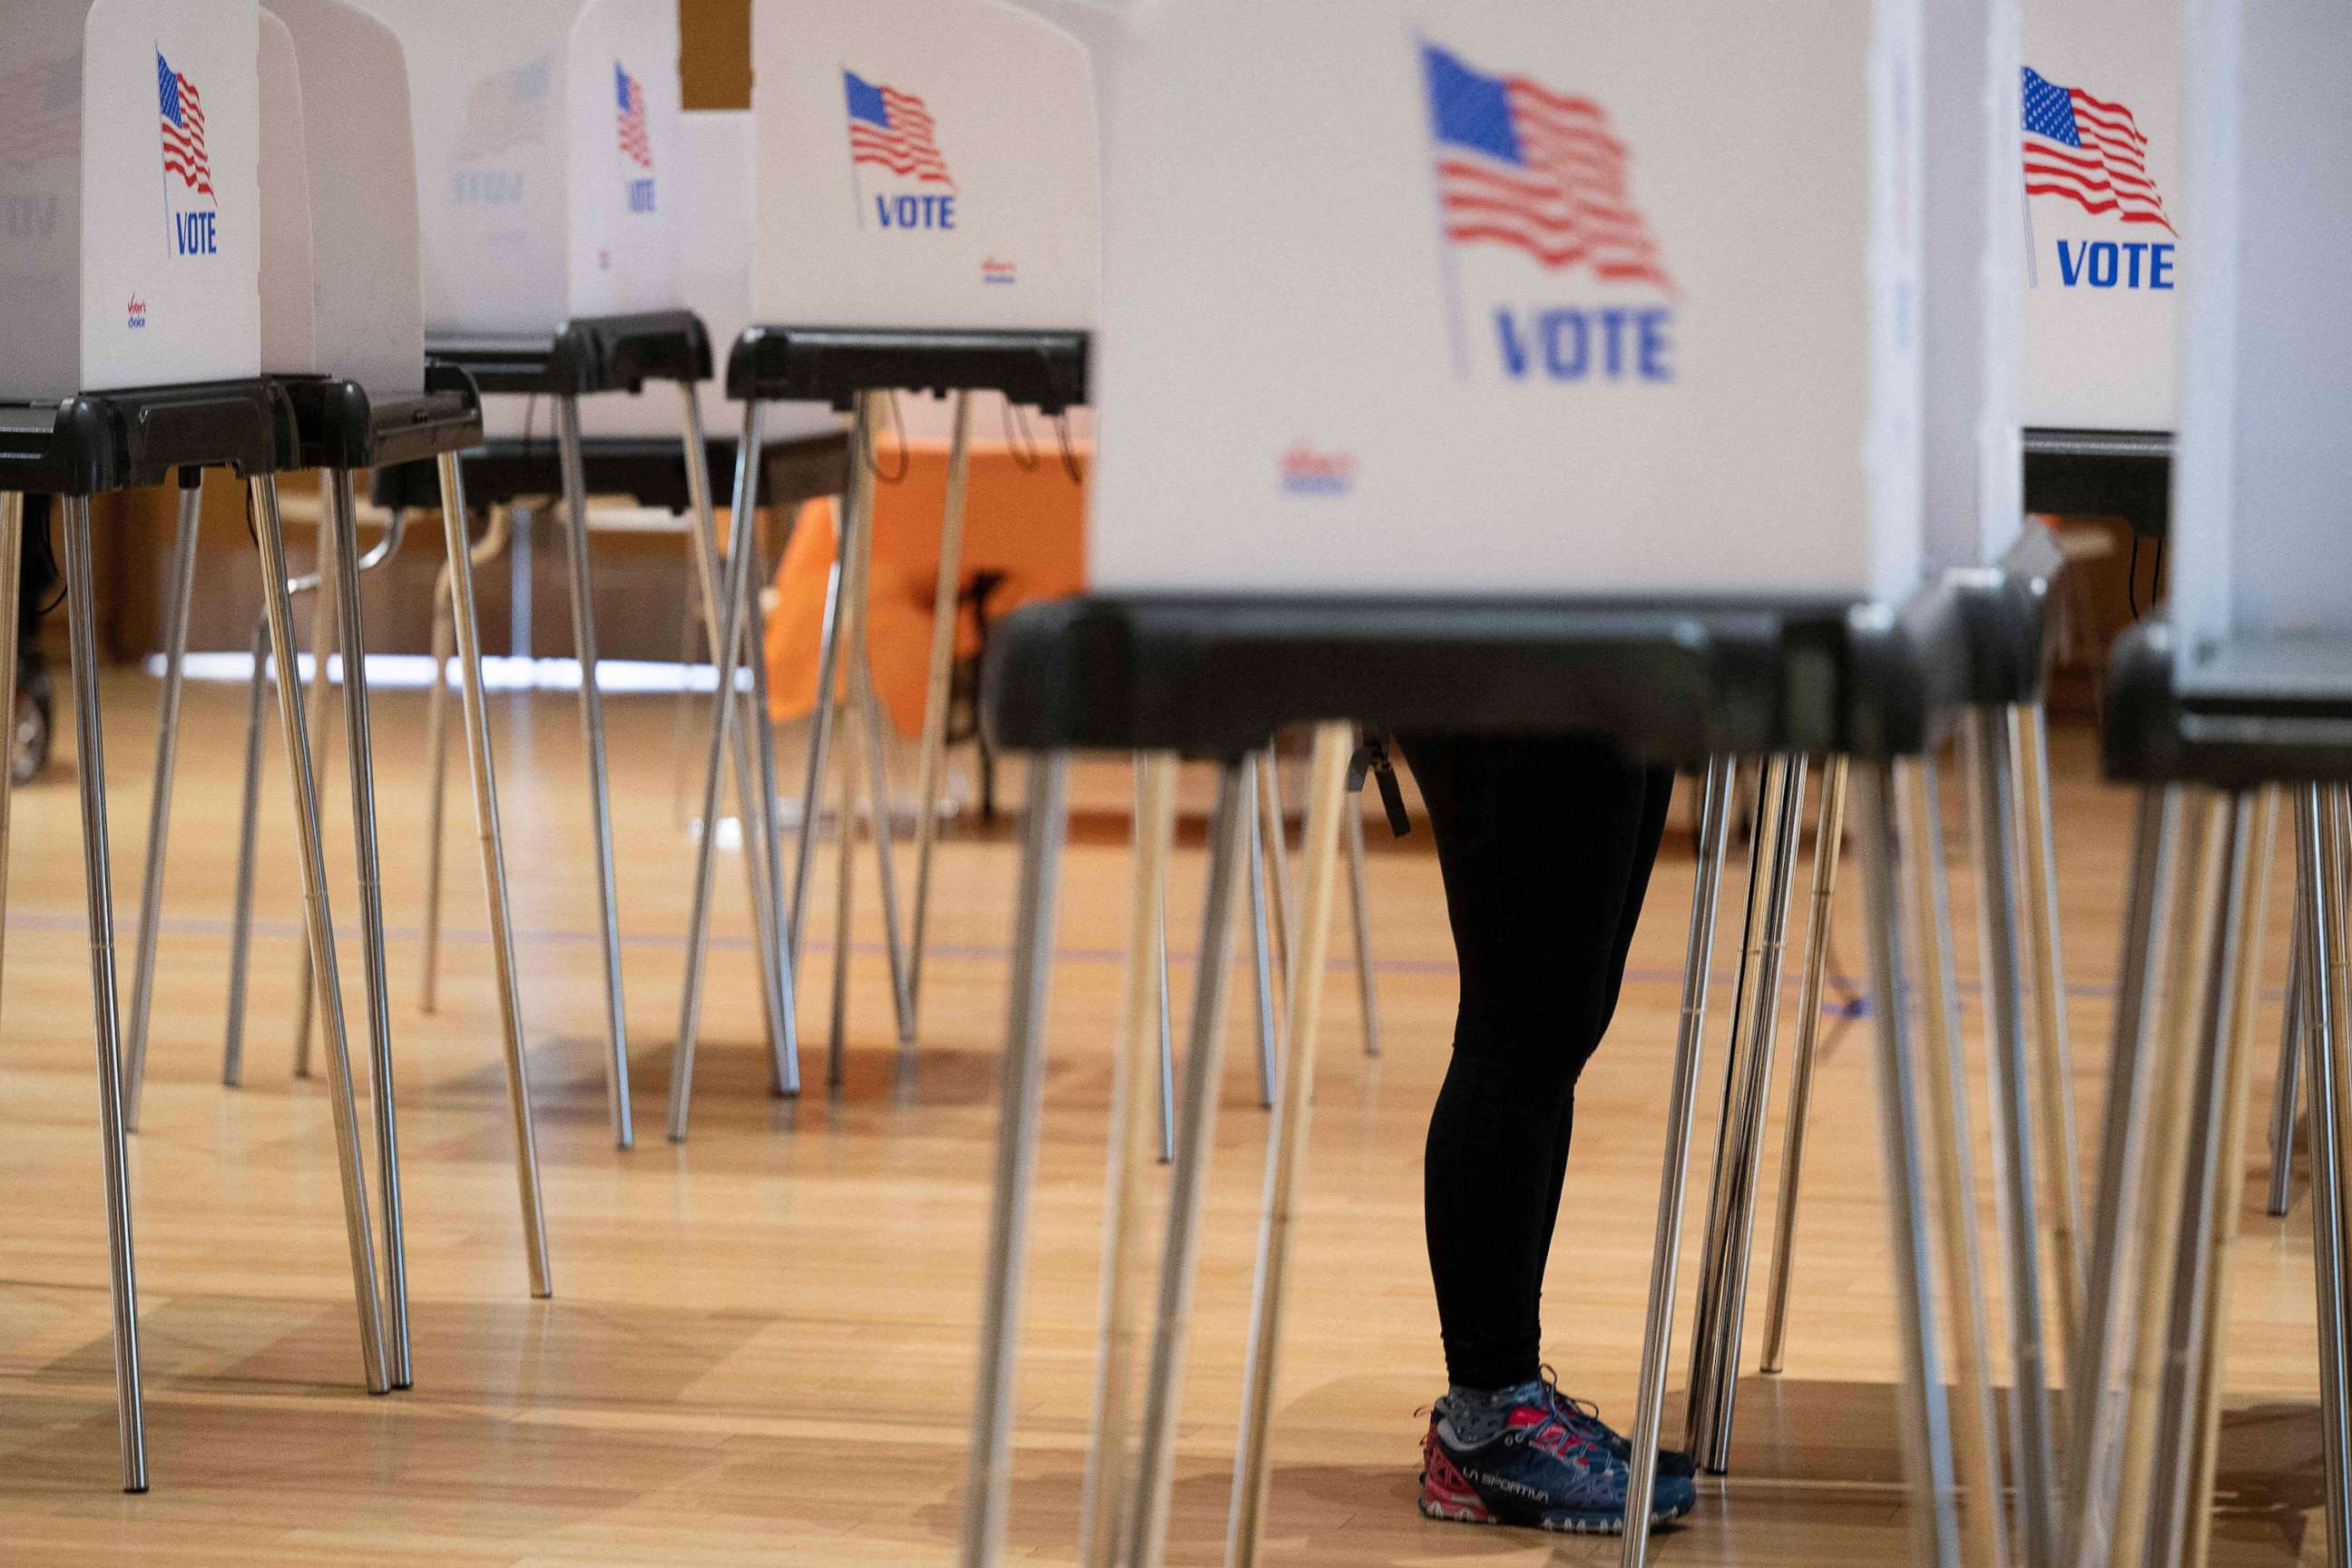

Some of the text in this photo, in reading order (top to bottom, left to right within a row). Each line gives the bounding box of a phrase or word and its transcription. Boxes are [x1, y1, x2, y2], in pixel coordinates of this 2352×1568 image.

[176, 211, 217, 255] VOTE
[876, 193, 956, 230] VOTE
[2056, 240, 2175, 289] VOTE
[1495, 305, 1674, 382] VOTE
[1463, 1465, 1549, 1504] LA SPORTIVA
